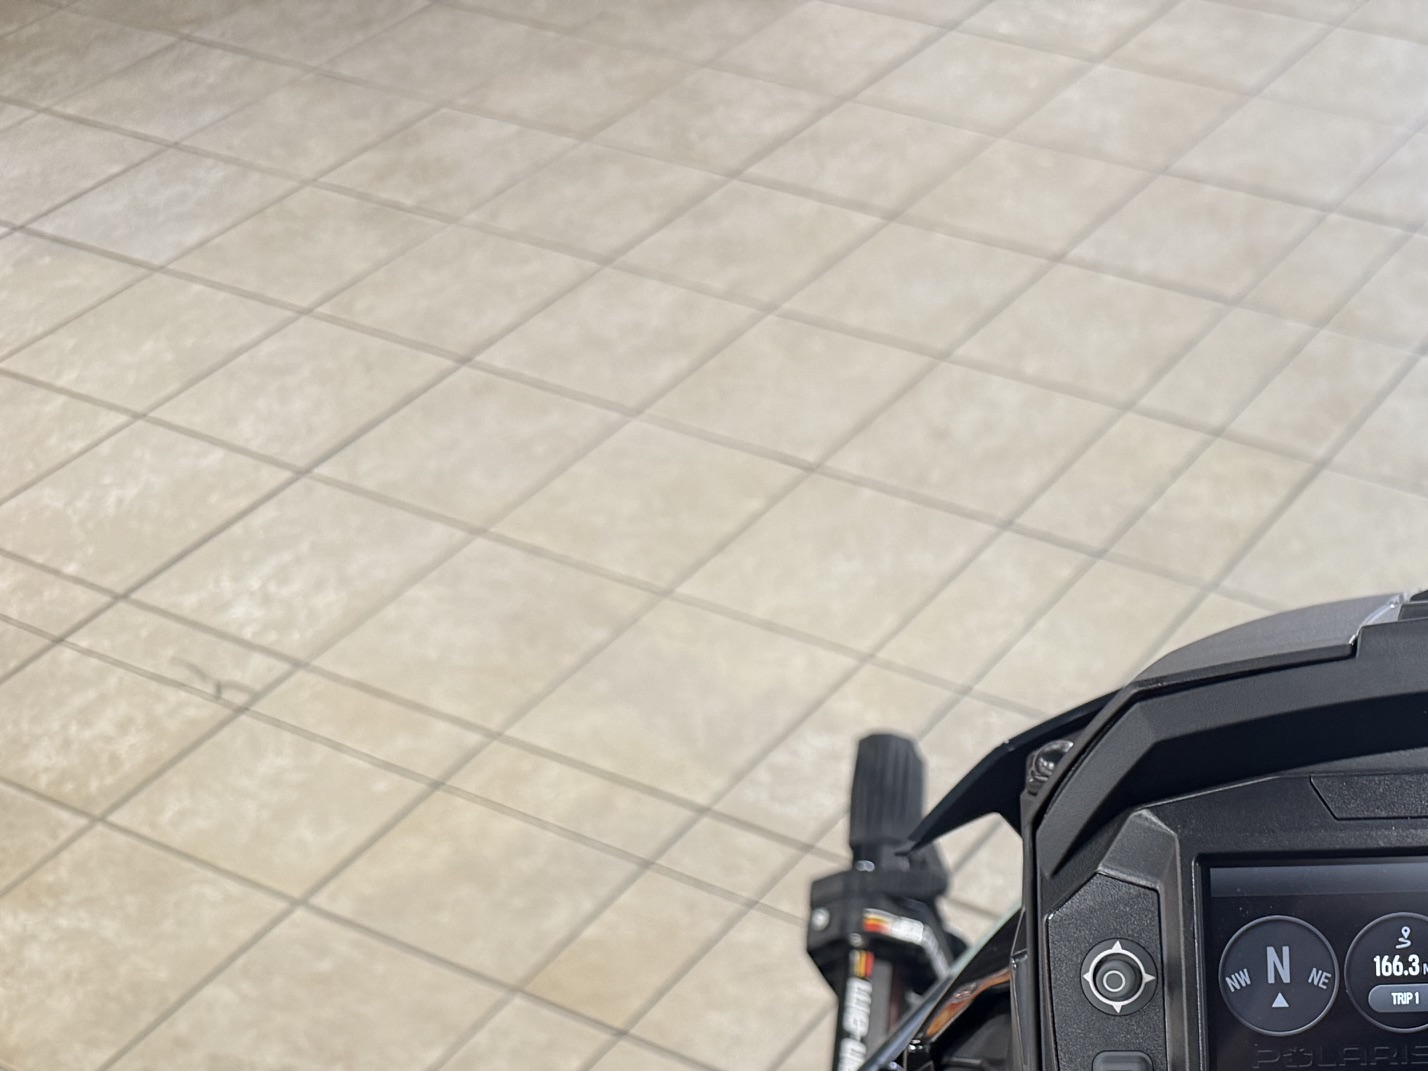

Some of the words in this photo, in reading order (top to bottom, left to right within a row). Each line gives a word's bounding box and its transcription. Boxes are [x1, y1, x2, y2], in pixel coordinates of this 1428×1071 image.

[1266, 946, 1291, 984] N
[1373, 954, 1420, 977] 166.3
[1225, 968, 1251, 992] NW
[1307, 967, 1332, 990] NE
[1391, 992, 1413, 1005] TRIP
[1414, 992, 1420, 1005] 1
